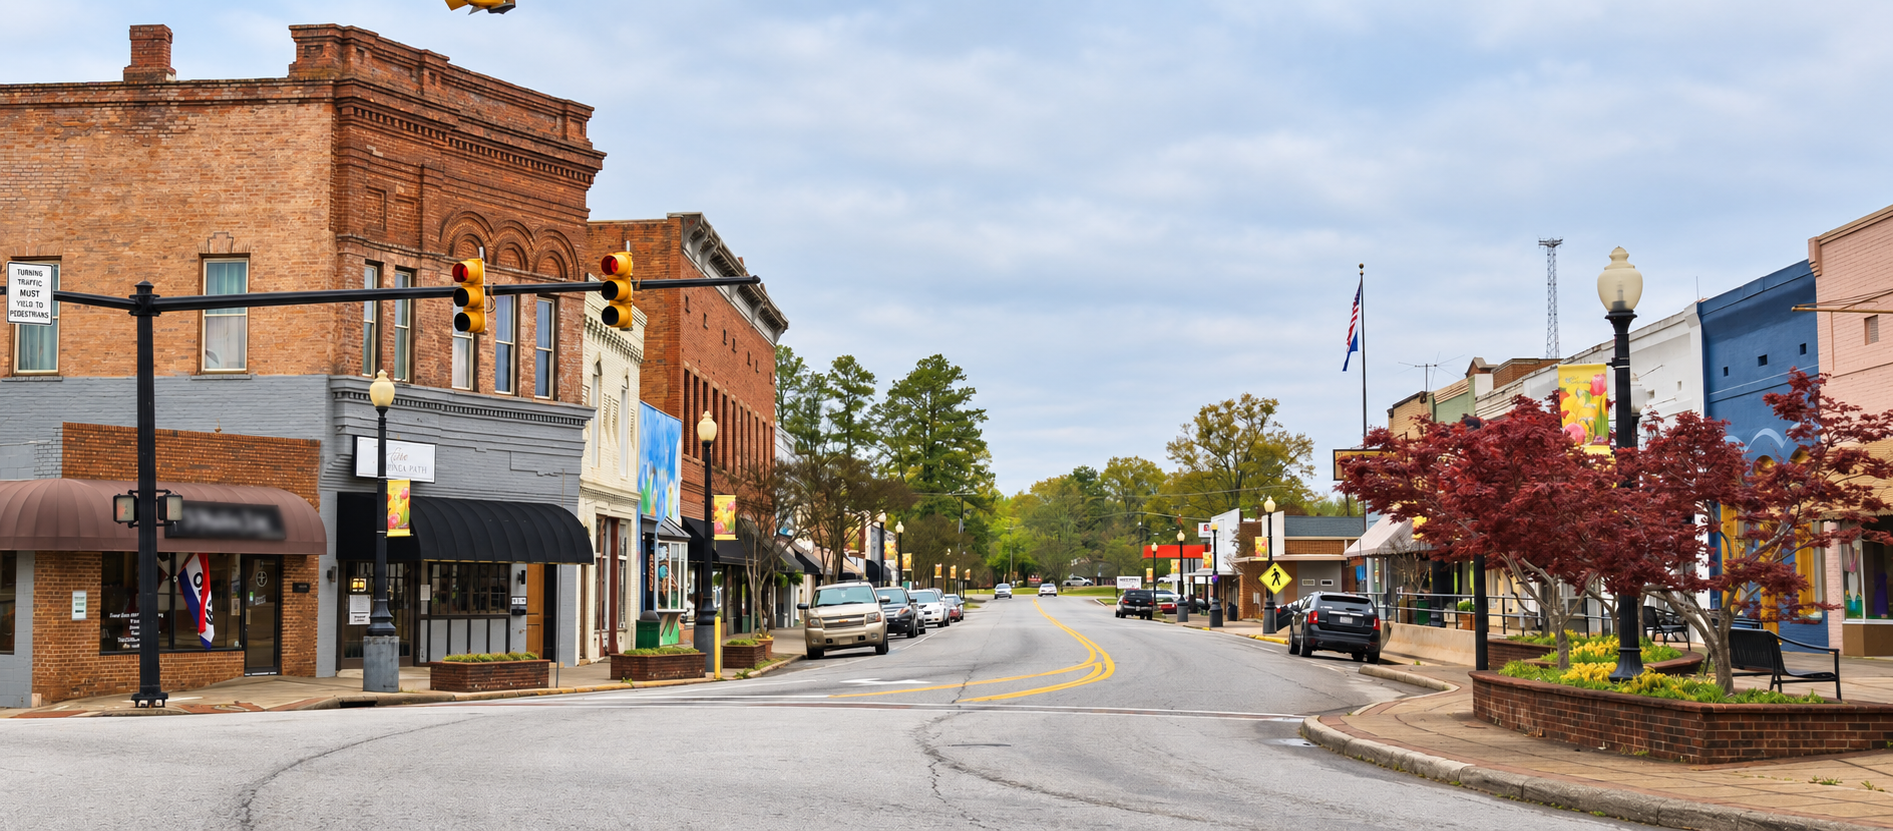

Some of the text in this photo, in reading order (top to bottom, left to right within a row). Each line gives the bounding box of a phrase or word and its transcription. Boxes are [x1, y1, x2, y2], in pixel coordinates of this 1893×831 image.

[17, 268, 43, 277] TURNING
[17, 278, 43, 287] TRAFFIC
[19, 289, 40, 298] MUST
[16, 300, 44, 309] YIELD TO
[9, 309, 50, 319] PEDESTRIANS
